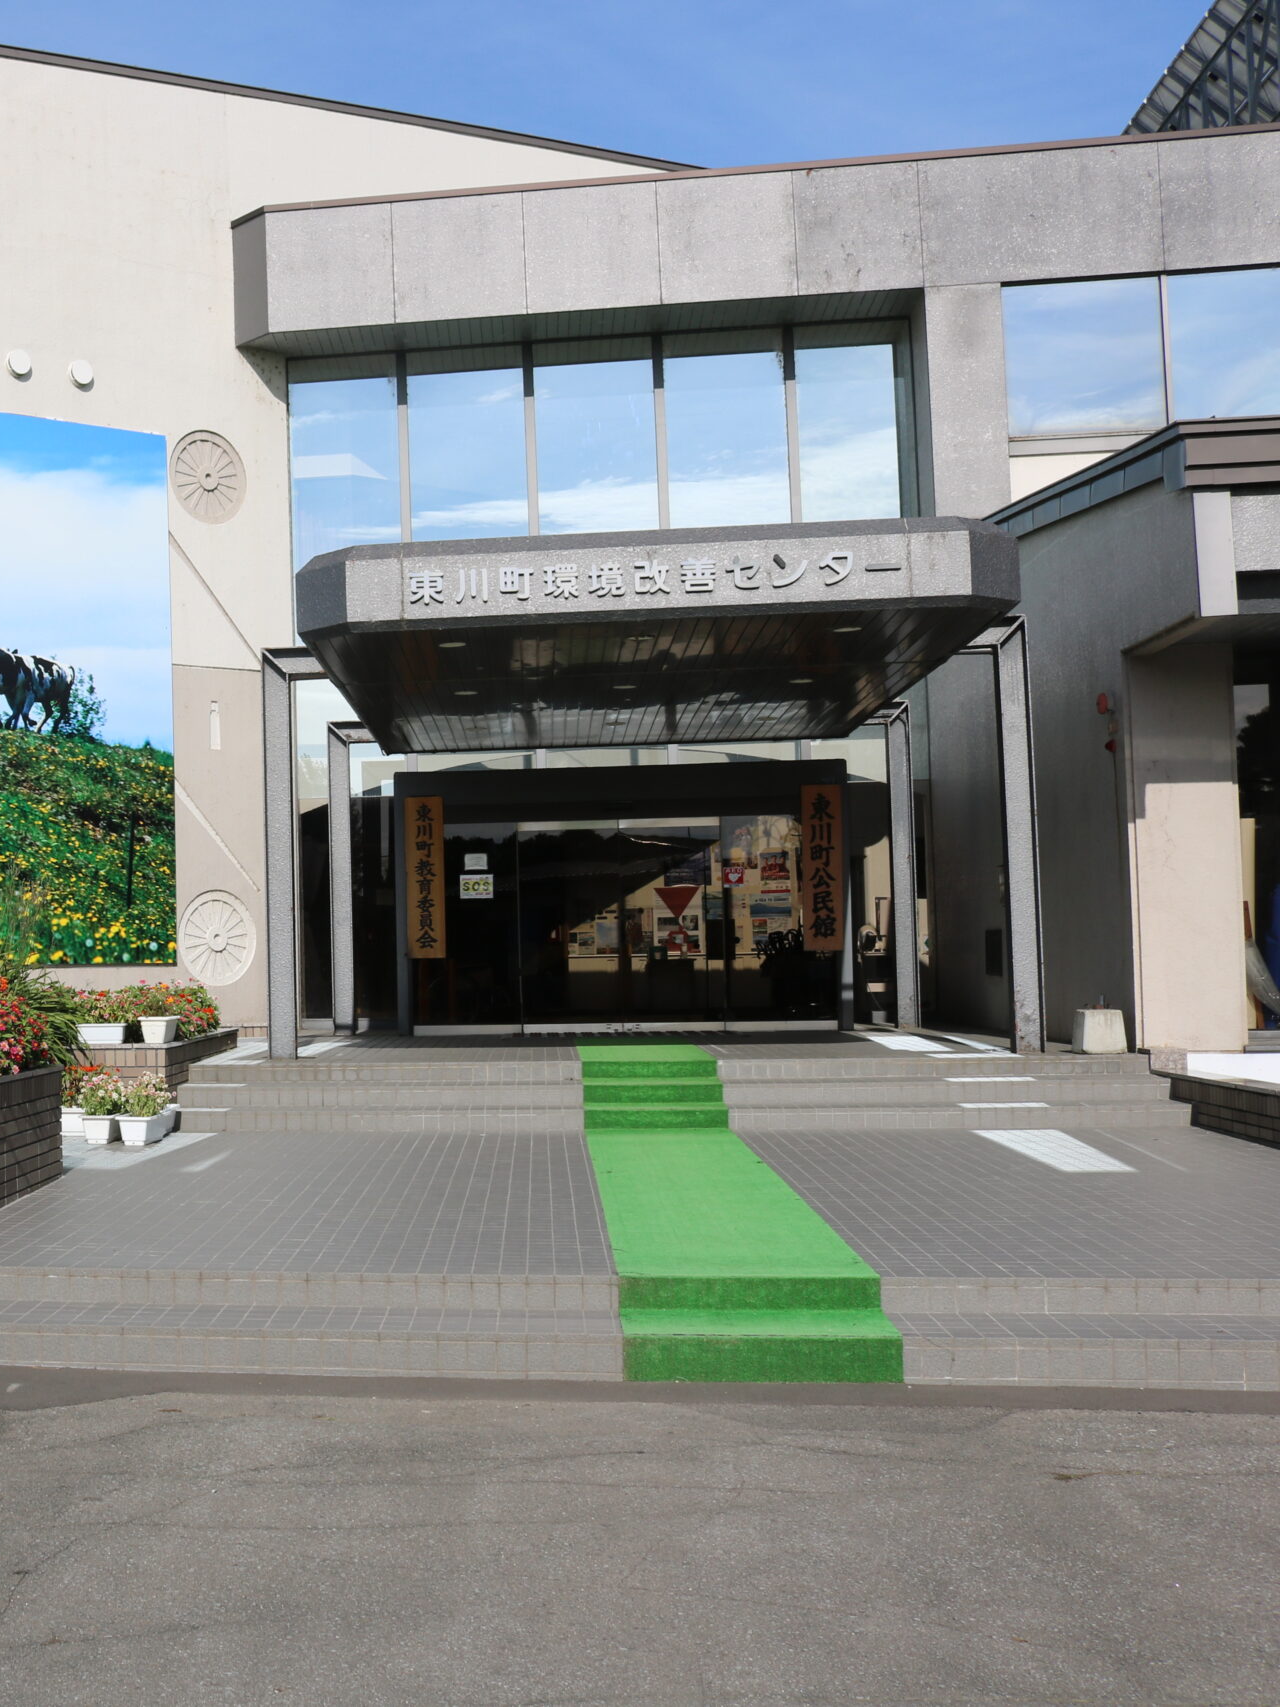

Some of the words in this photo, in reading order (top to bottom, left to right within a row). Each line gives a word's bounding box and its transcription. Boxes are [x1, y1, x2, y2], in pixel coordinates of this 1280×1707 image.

[409, 551, 903, 606] 東川町環境改善センター
[415, 803, 439, 949] 東川町教育委員会
[808, 793, 836, 941] 東川町公民館
